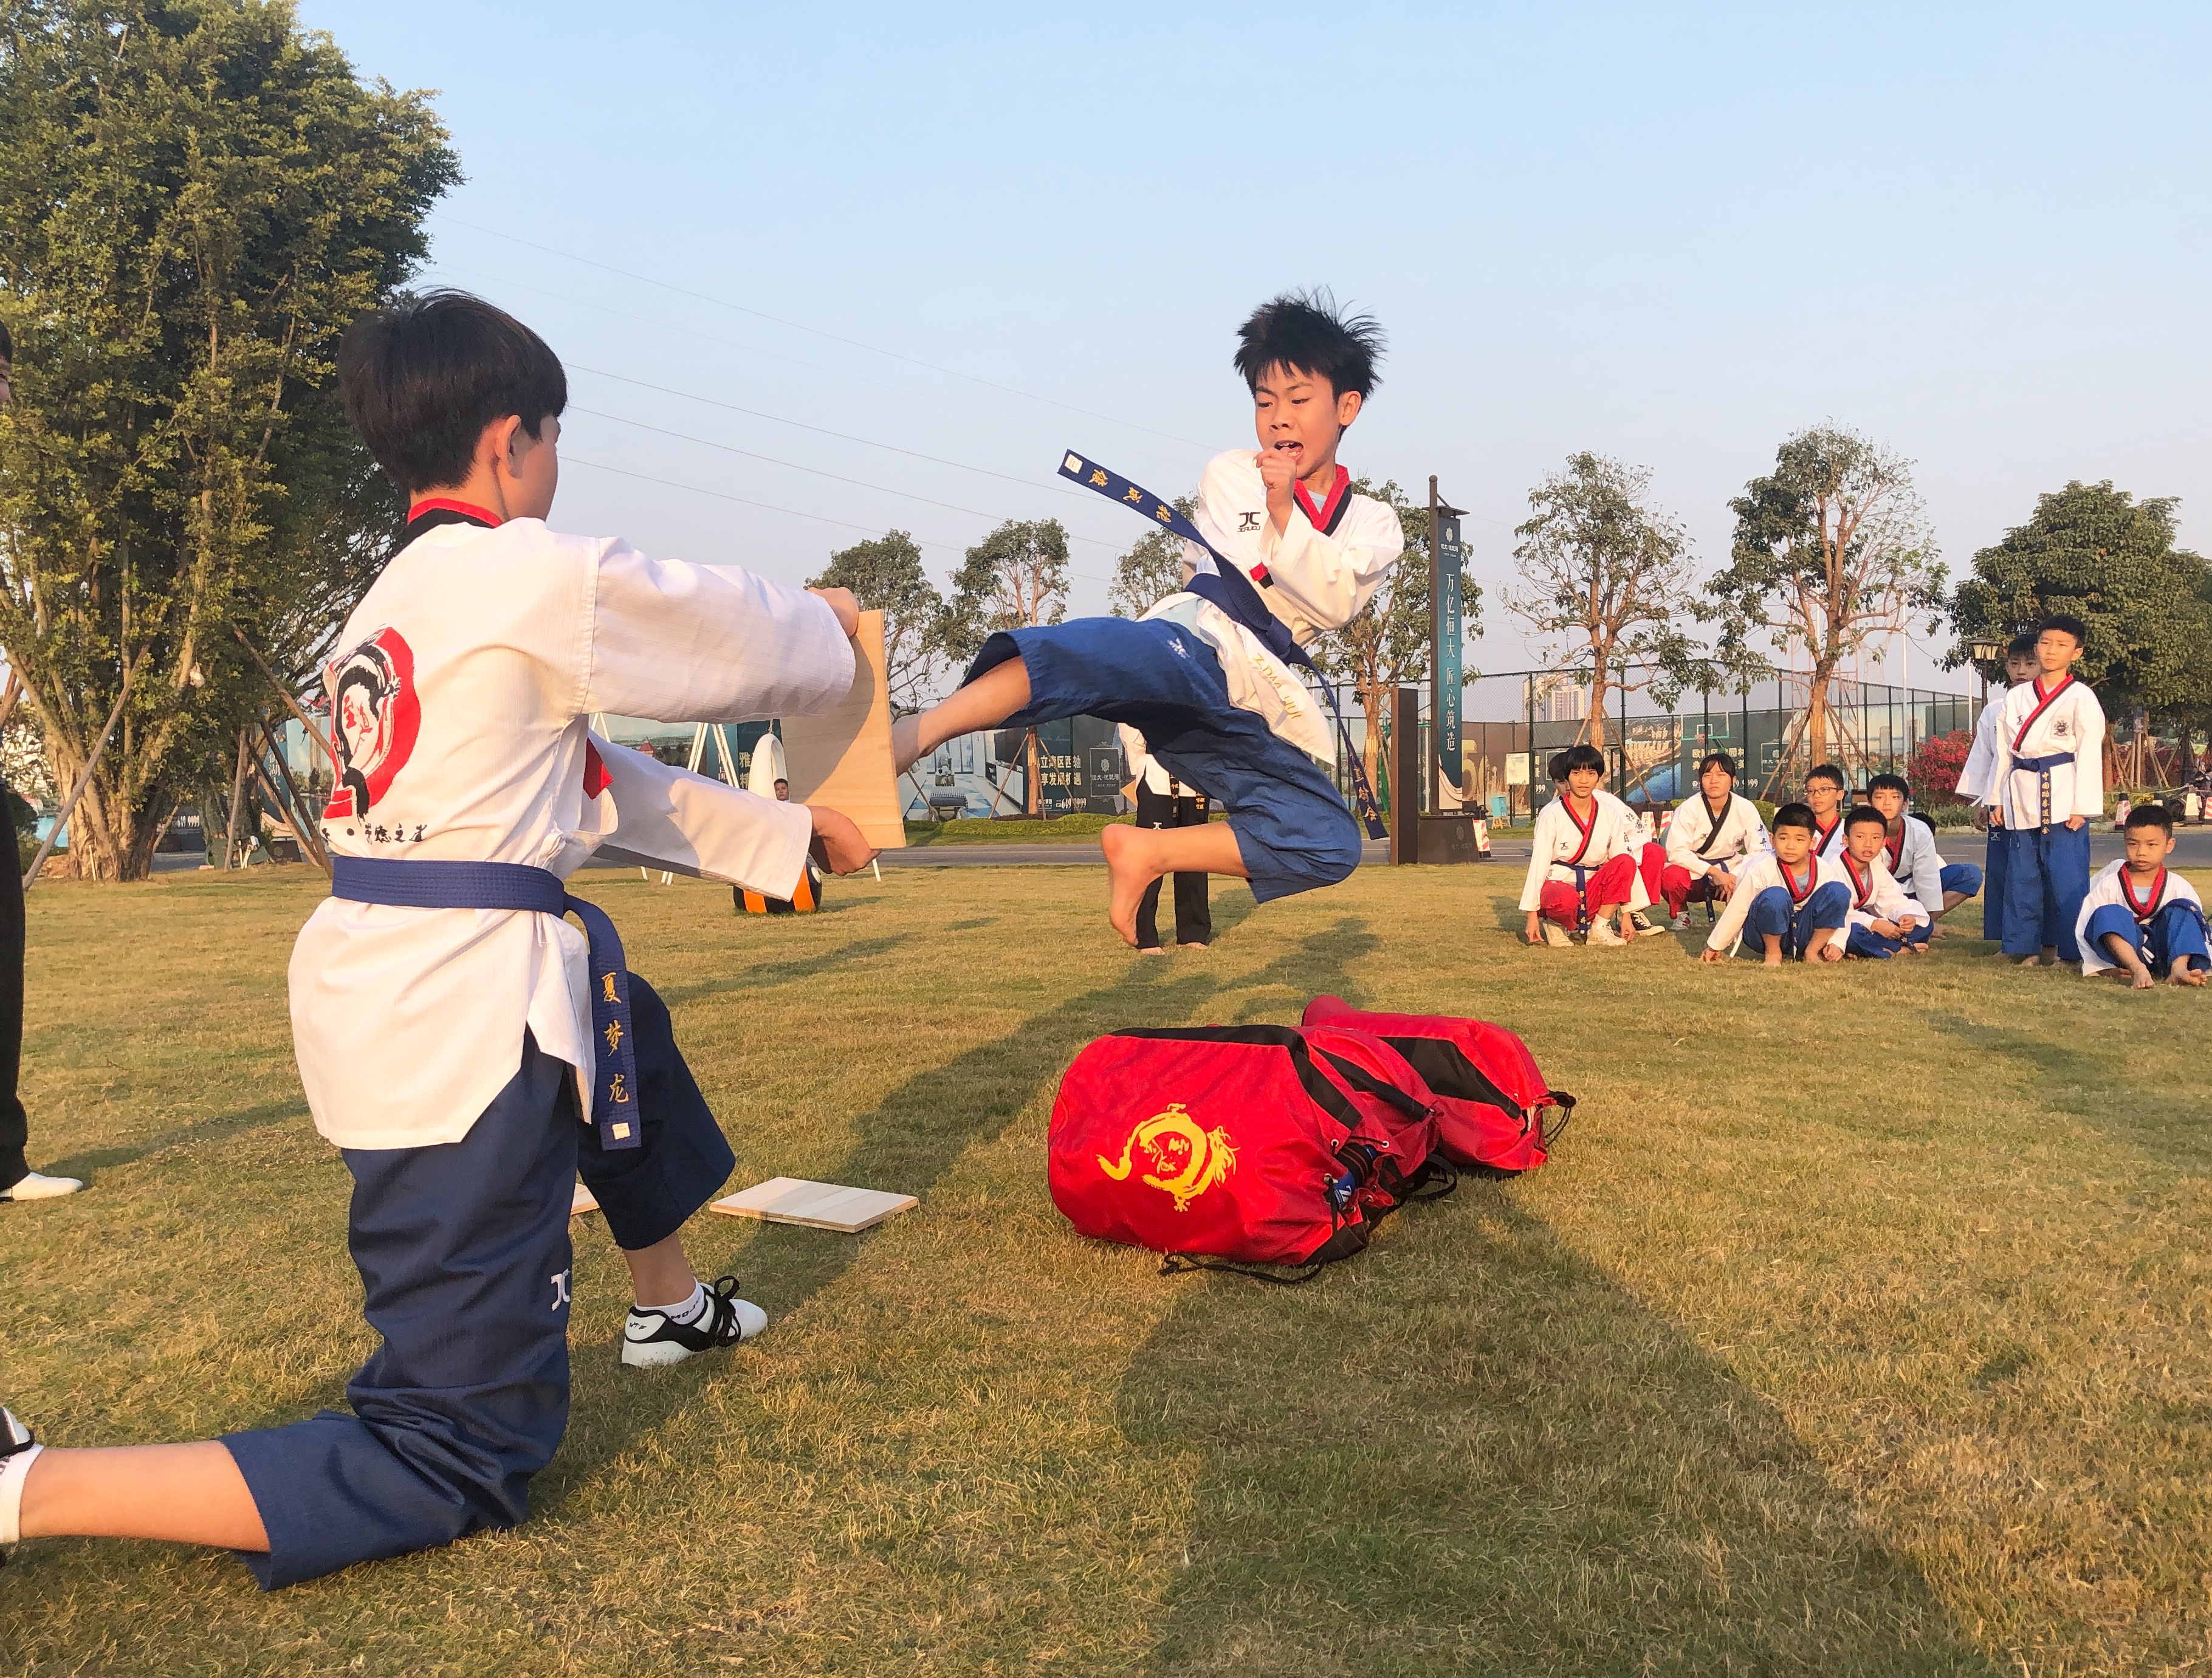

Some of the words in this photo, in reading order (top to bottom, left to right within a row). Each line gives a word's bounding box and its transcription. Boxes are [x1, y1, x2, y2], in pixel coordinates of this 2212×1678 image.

[1446, 573, 1455, 659] 万亿恒大
[1446, 667, 1456, 752] 匠心筑造
[601, 972, 630, 1104] 夏梦龙
